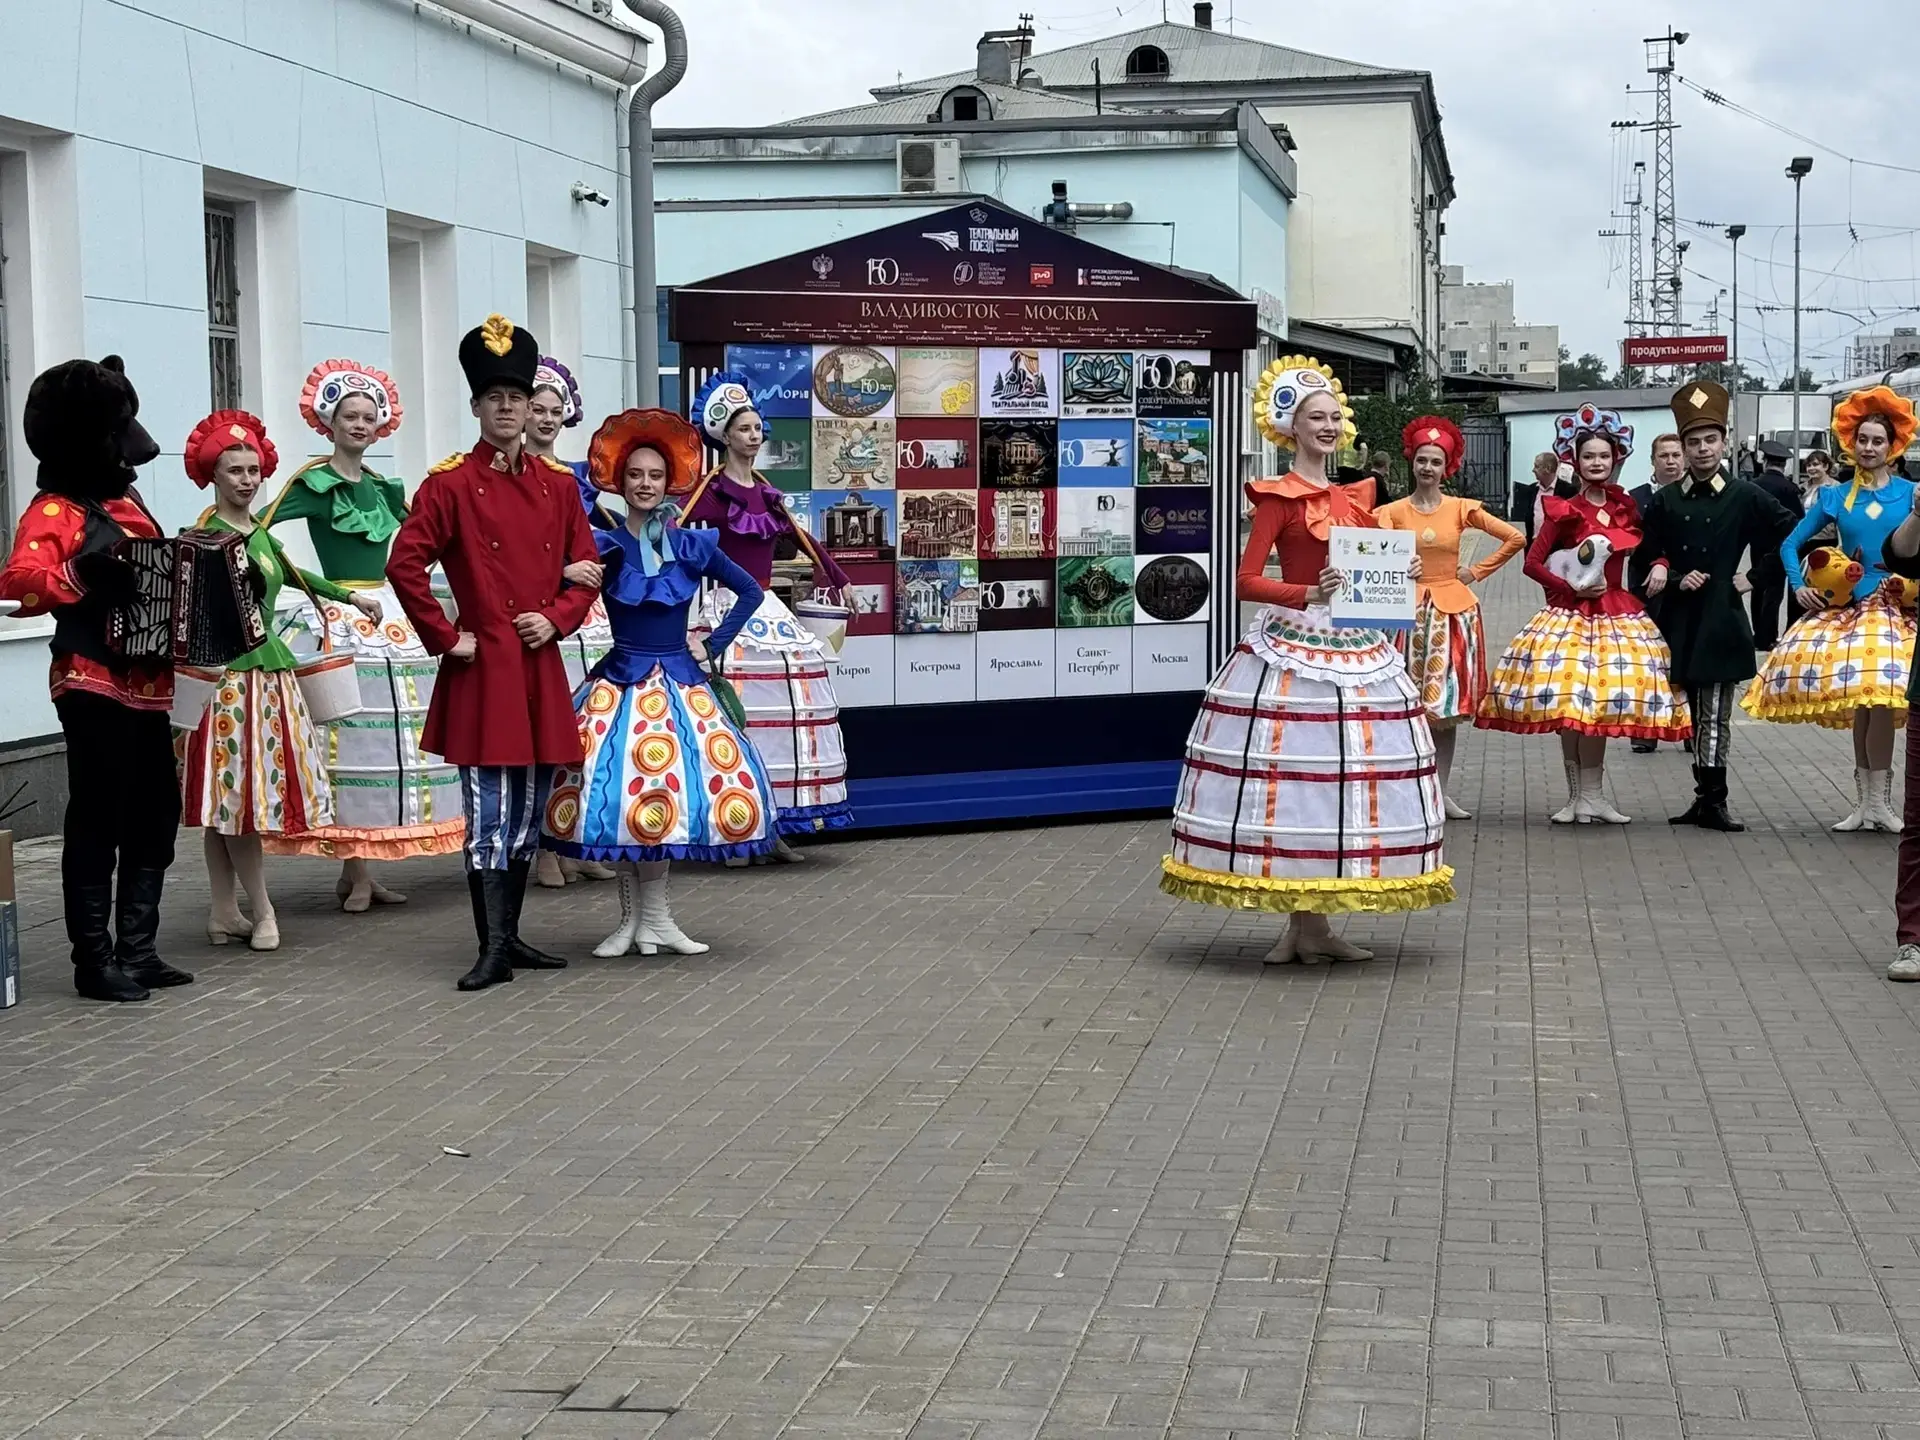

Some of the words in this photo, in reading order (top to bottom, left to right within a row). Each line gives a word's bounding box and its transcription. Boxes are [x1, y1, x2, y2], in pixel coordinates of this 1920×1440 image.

[968, 227, 1019, 241] ТЕАТРАЛЬНЫЙ
[969, 240, 995, 253] ПОЕЗД
[861, 301, 1000, 320] ВЛАДИВОСТОК
[1024, 304, 1100, 321] МОСКВА
[1166, 509, 1207, 522] ОМСК
[1364, 570, 1381, 585] 90
[1382, 570, 1406, 585] ЛЕТ
[1364, 586, 1406, 597] КИРОВСКАЯ
[1365, 596, 1391, 604] ОБЛАСТЬ
[1077, 647, 1112, 658] Санкт-
[1152, 653, 1189, 664] Москва
[836, 664, 871, 678] Киров
[910, 661, 961, 675] Кострома
[990, 658, 1043, 674] Ярославль
[1068, 660, 1121, 676] Петербург
